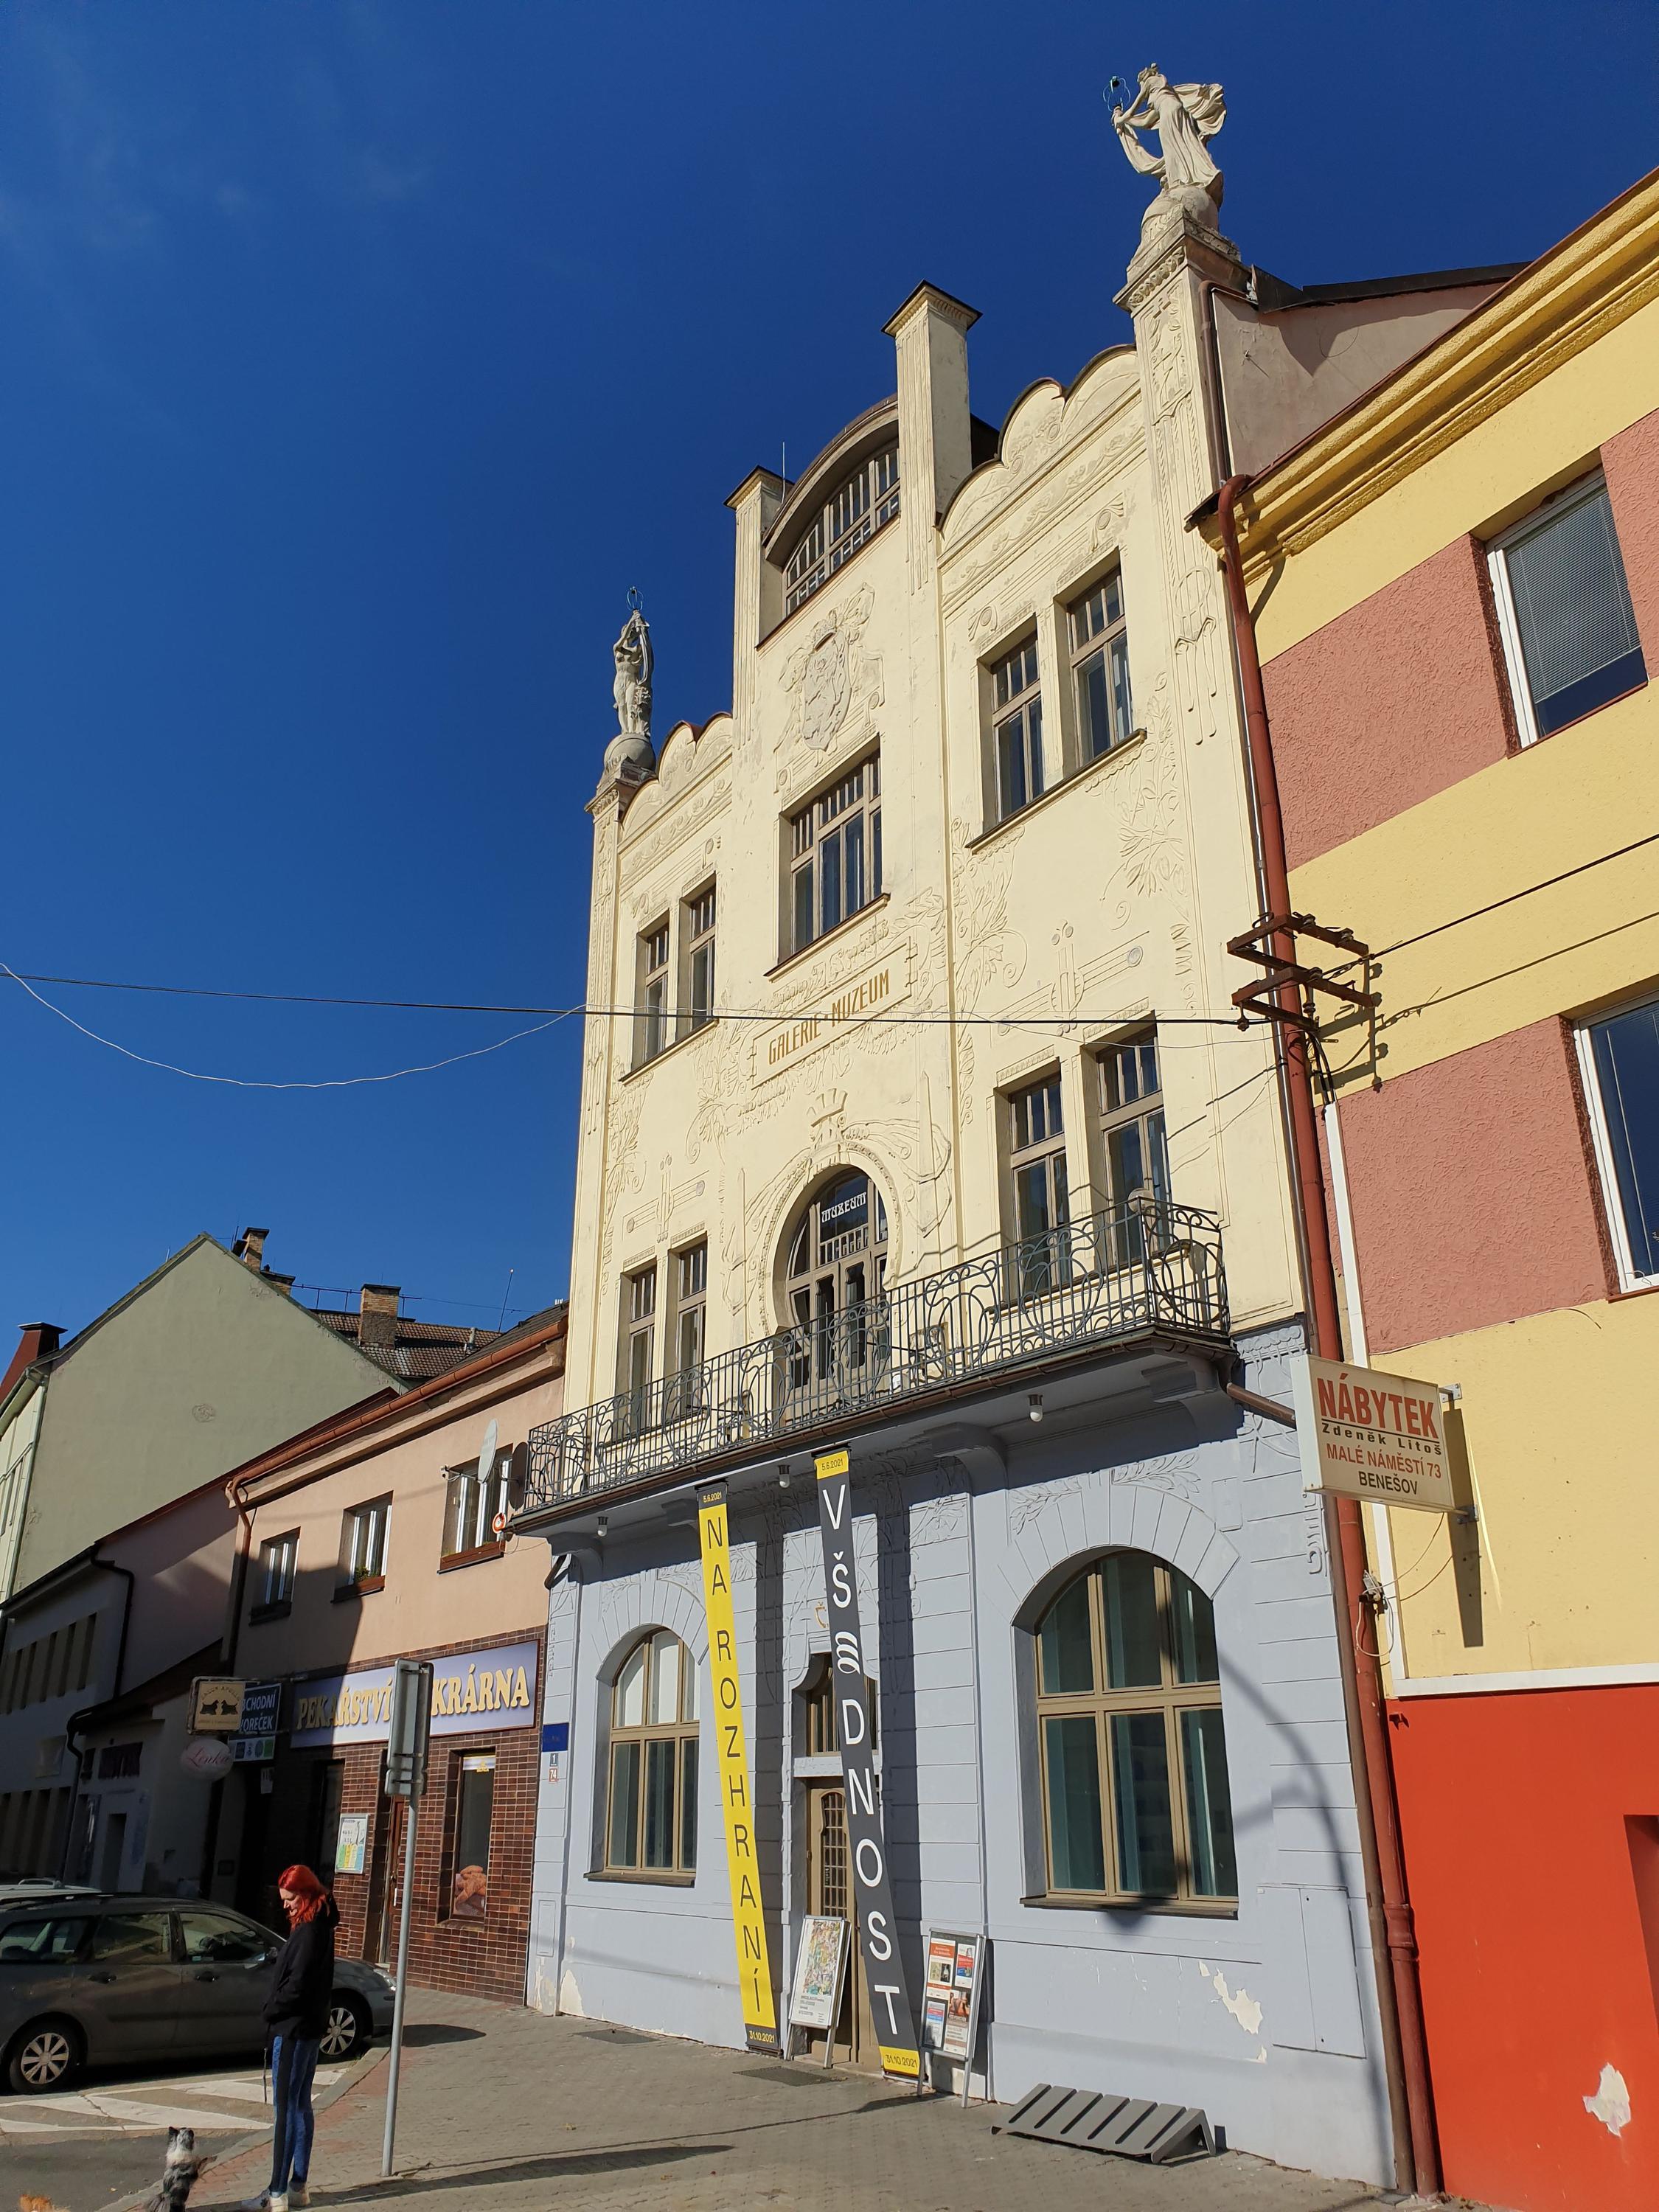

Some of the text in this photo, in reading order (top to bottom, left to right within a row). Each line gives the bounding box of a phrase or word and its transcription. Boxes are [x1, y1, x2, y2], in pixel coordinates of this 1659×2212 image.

[768, 968, 890, 1065] GALERIE MUZEUM
[821, 1192, 867, 1223] MUZEUM
[1317, 1372, 1439, 1439] NÁBYTEK
[1321, 1422, 1442, 1455] Zdeněk Litoš
[821, 1458, 844, 1471] 5.6.2021
[1326, 1442, 1441, 1479] MALÉ NÁMĚSTÍ 73
[1358, 1470, 1418, 1495] BENEŠOV
[241, 1688, 277, 1711] BCHODNÍ
[296, 1663, 530, 1730] PEKAŘSTVÍ KRÁRNA
[241, 1711, 274, 1732] OREČEK
[550, 1769, 557, 1779] 74
[748, 2030, 775, 2044] 31.10.2021
[885, 2054, 918, 2067] 31.10.2021
